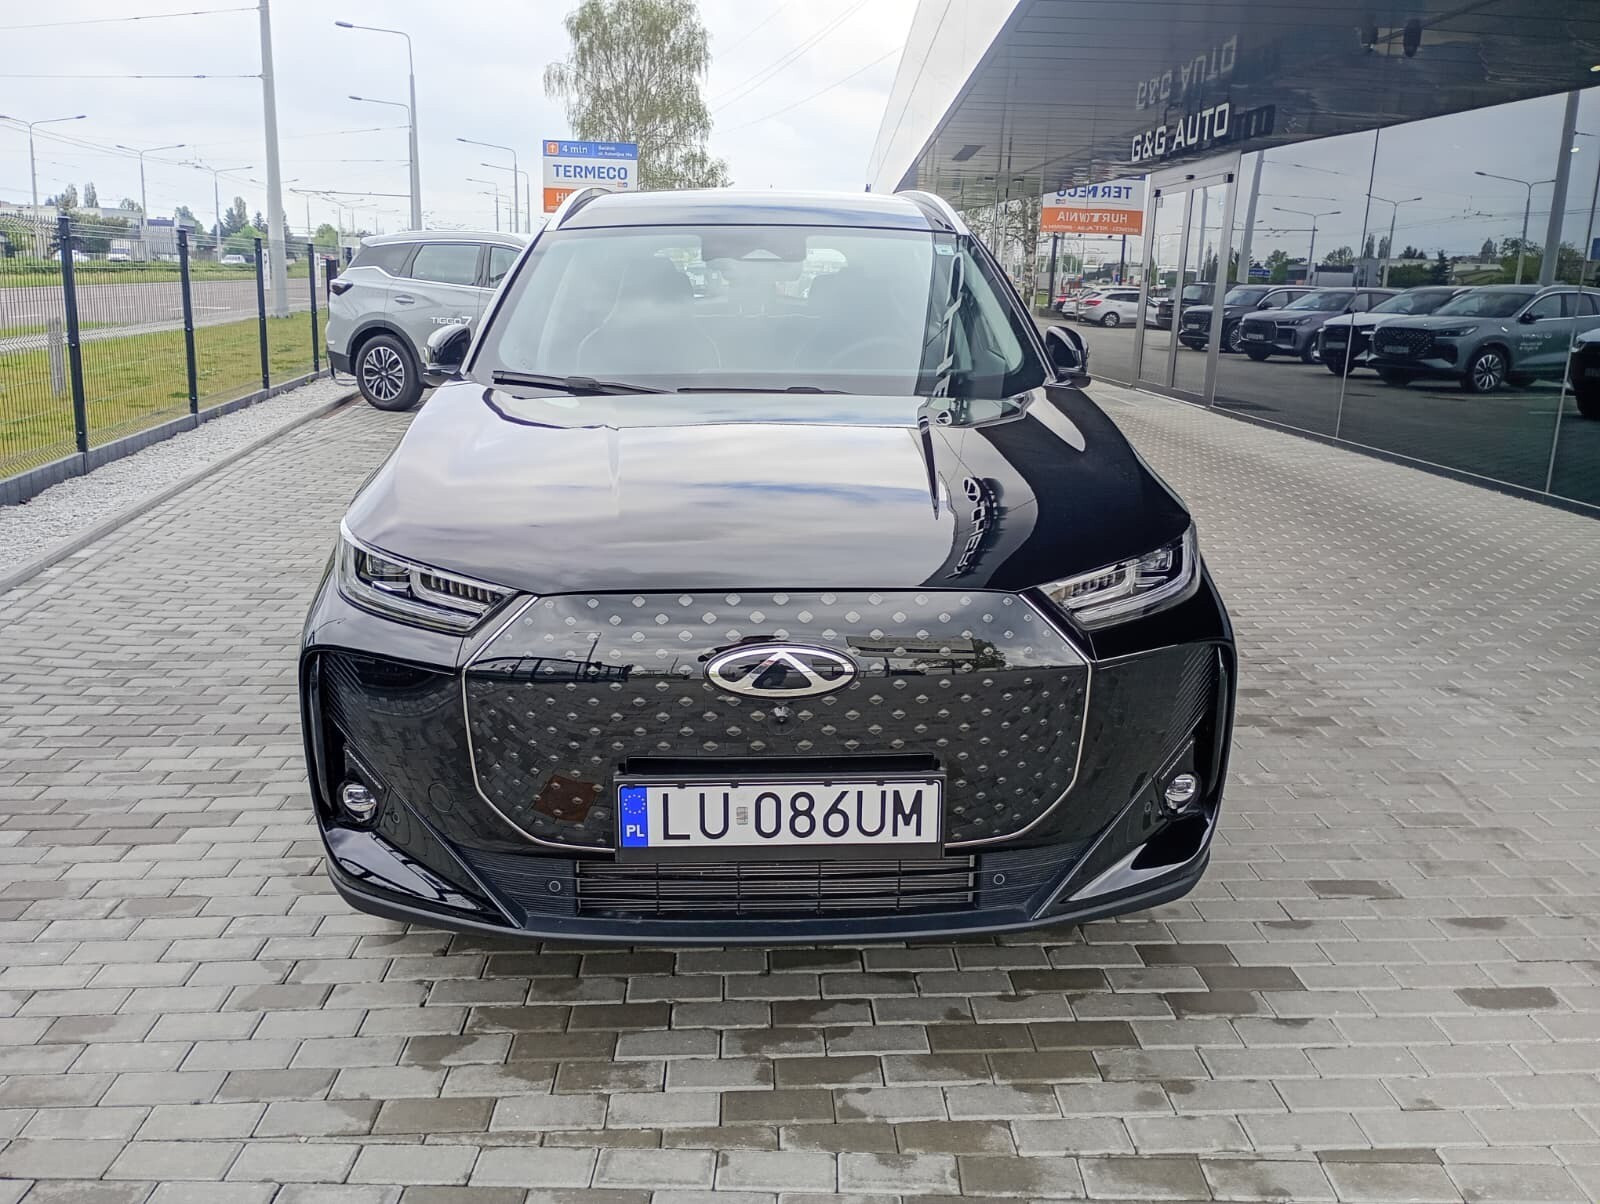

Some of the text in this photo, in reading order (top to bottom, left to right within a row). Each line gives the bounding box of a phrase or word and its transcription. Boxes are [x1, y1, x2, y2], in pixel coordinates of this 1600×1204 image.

[1131, 102, 1230, 162] G&G AUTO
[562, 143, 569, 153] 4
[570, 143, 588, 153] min
[552, 164, 629, 181] TERMECO
[662, 789, 924, 841] LU 086UM
[626, 824, 645, 838] PL
